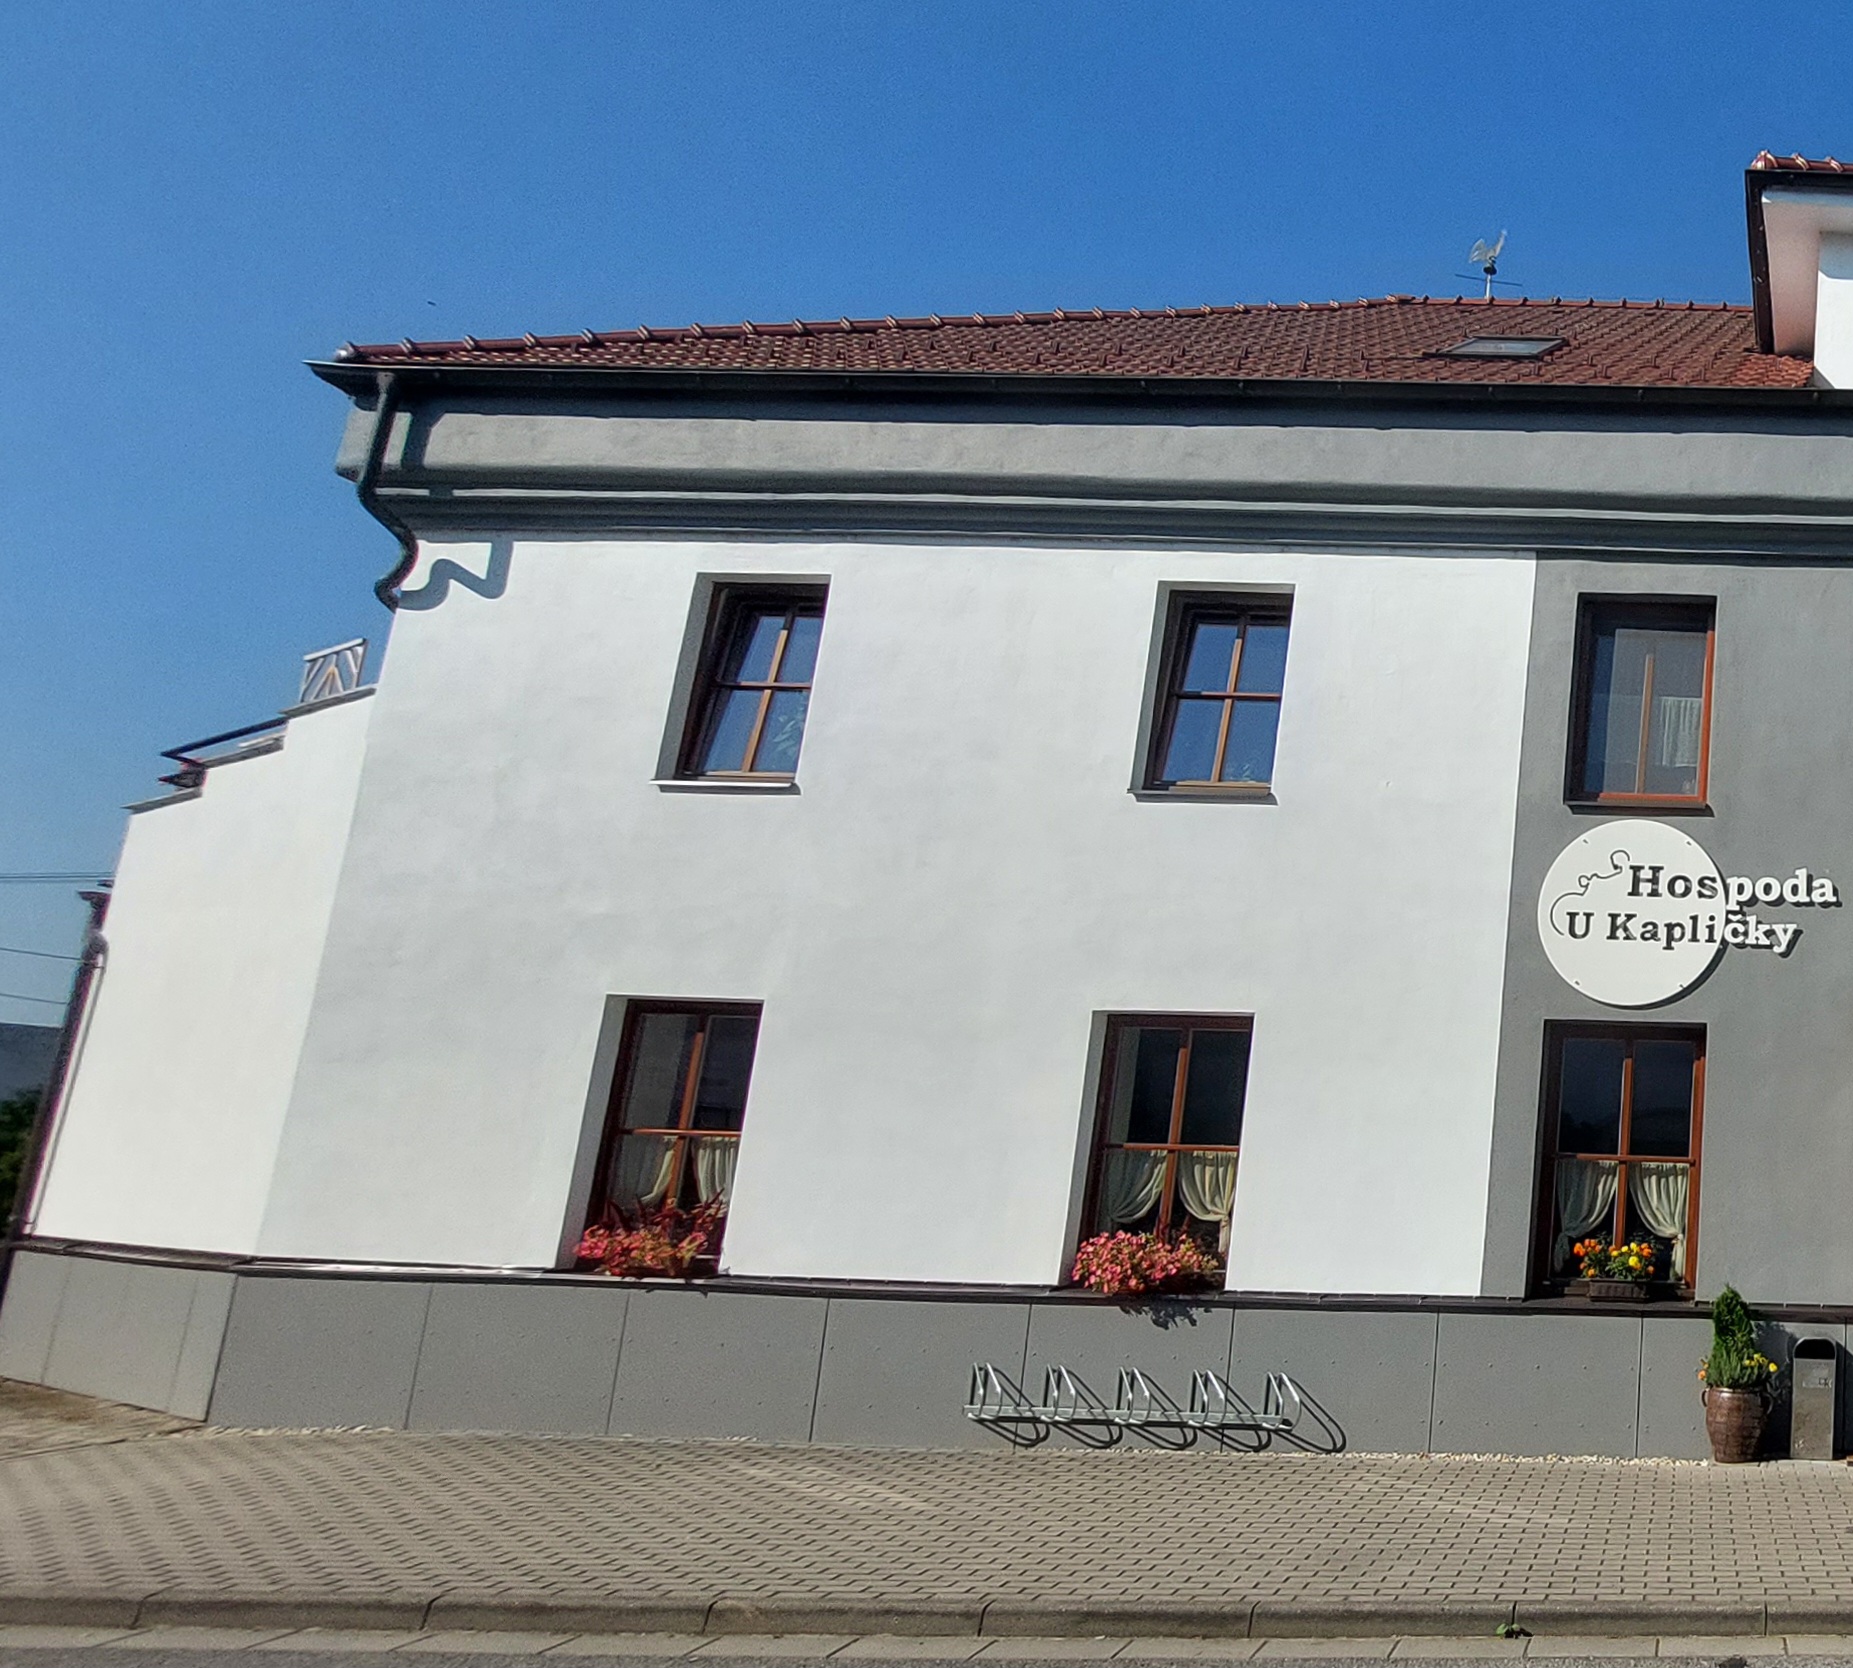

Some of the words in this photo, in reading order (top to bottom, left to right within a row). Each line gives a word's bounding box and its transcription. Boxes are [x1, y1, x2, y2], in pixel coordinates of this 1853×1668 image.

[1627, 865, 1837, 911] Hospoda
[1566, 912, 1594, 939] U
[1606, 912, 1797, 952] Kapličky
